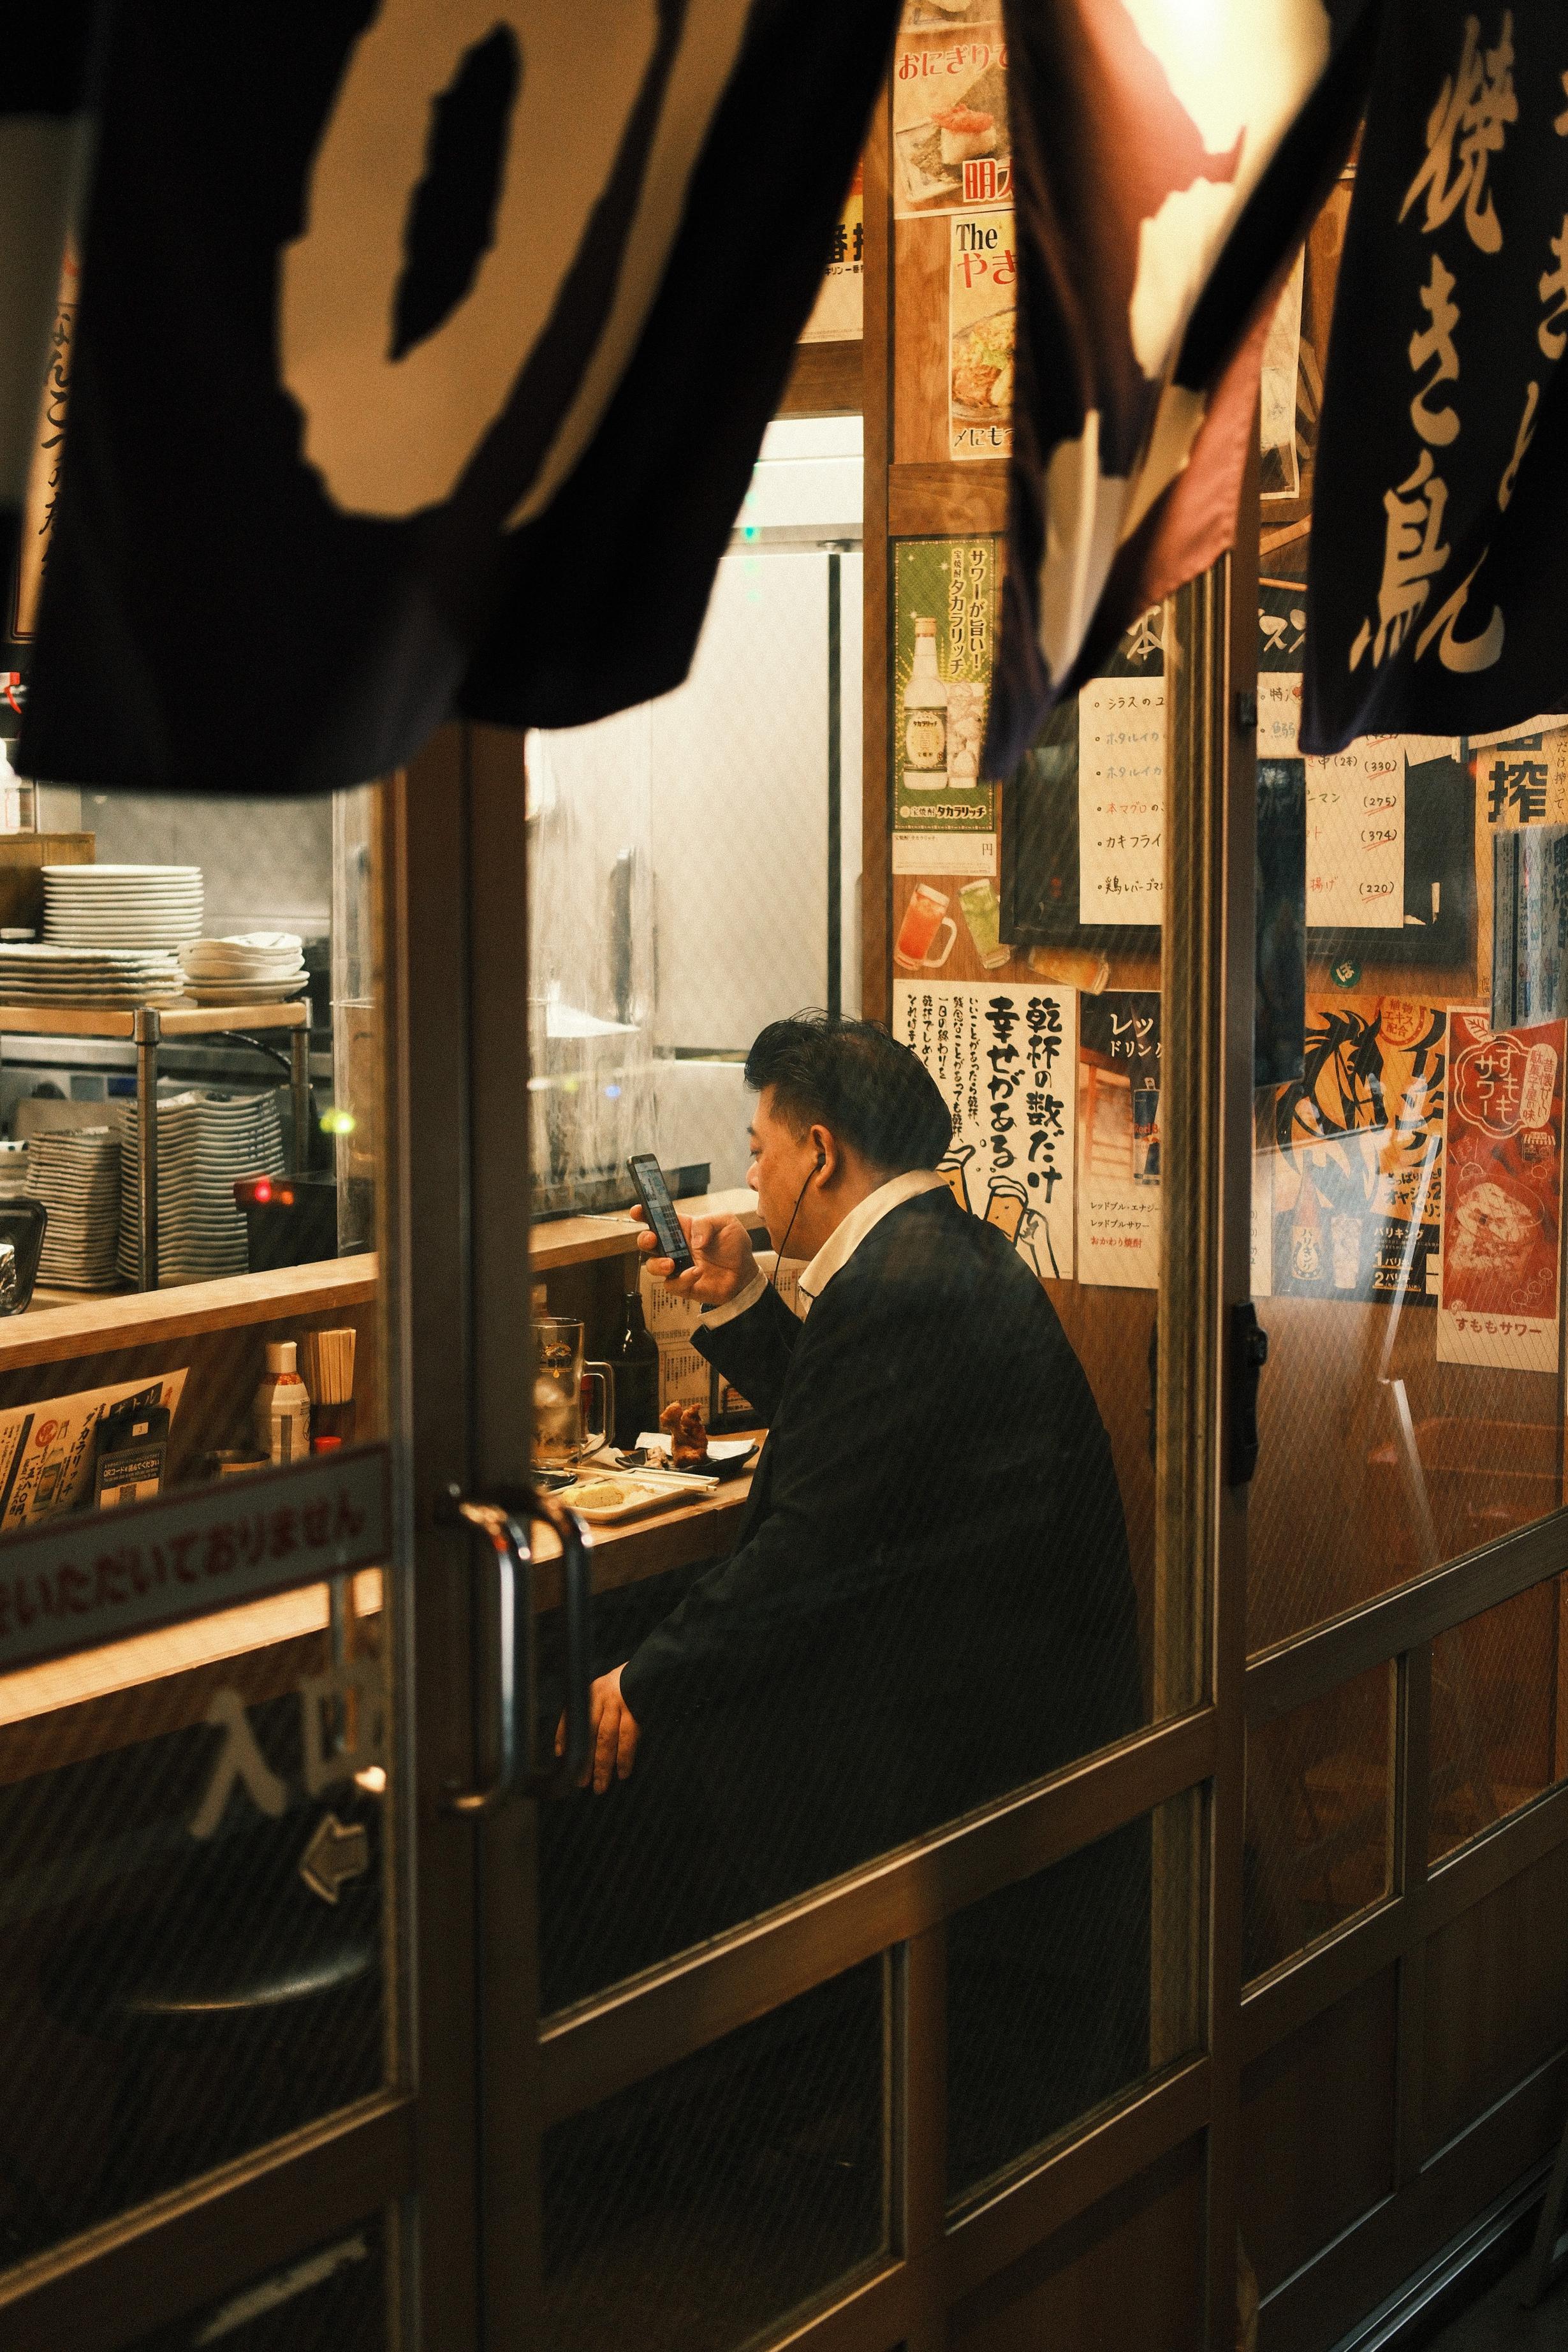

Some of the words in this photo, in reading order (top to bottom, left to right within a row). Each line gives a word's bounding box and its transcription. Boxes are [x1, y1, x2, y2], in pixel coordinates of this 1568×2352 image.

[956, 223, 998, 251] The
[1364, 760, 1397, 773] (330)
[1307, 790, 1340, 804] ーマン
[1363, 796, 1396, 809] (275)
[1361, 829, 1398, 843] (374)
[1359, 881, 1395, 895] (220)
[985, 996, 1025, 1168] 幸せがある
[1025, 997, 1064, 1203] 乾杯の数だけ
[1456, 1318, 1542, 1337] すももサワー
[0, 1483, 366, 1633] いただいておりません
